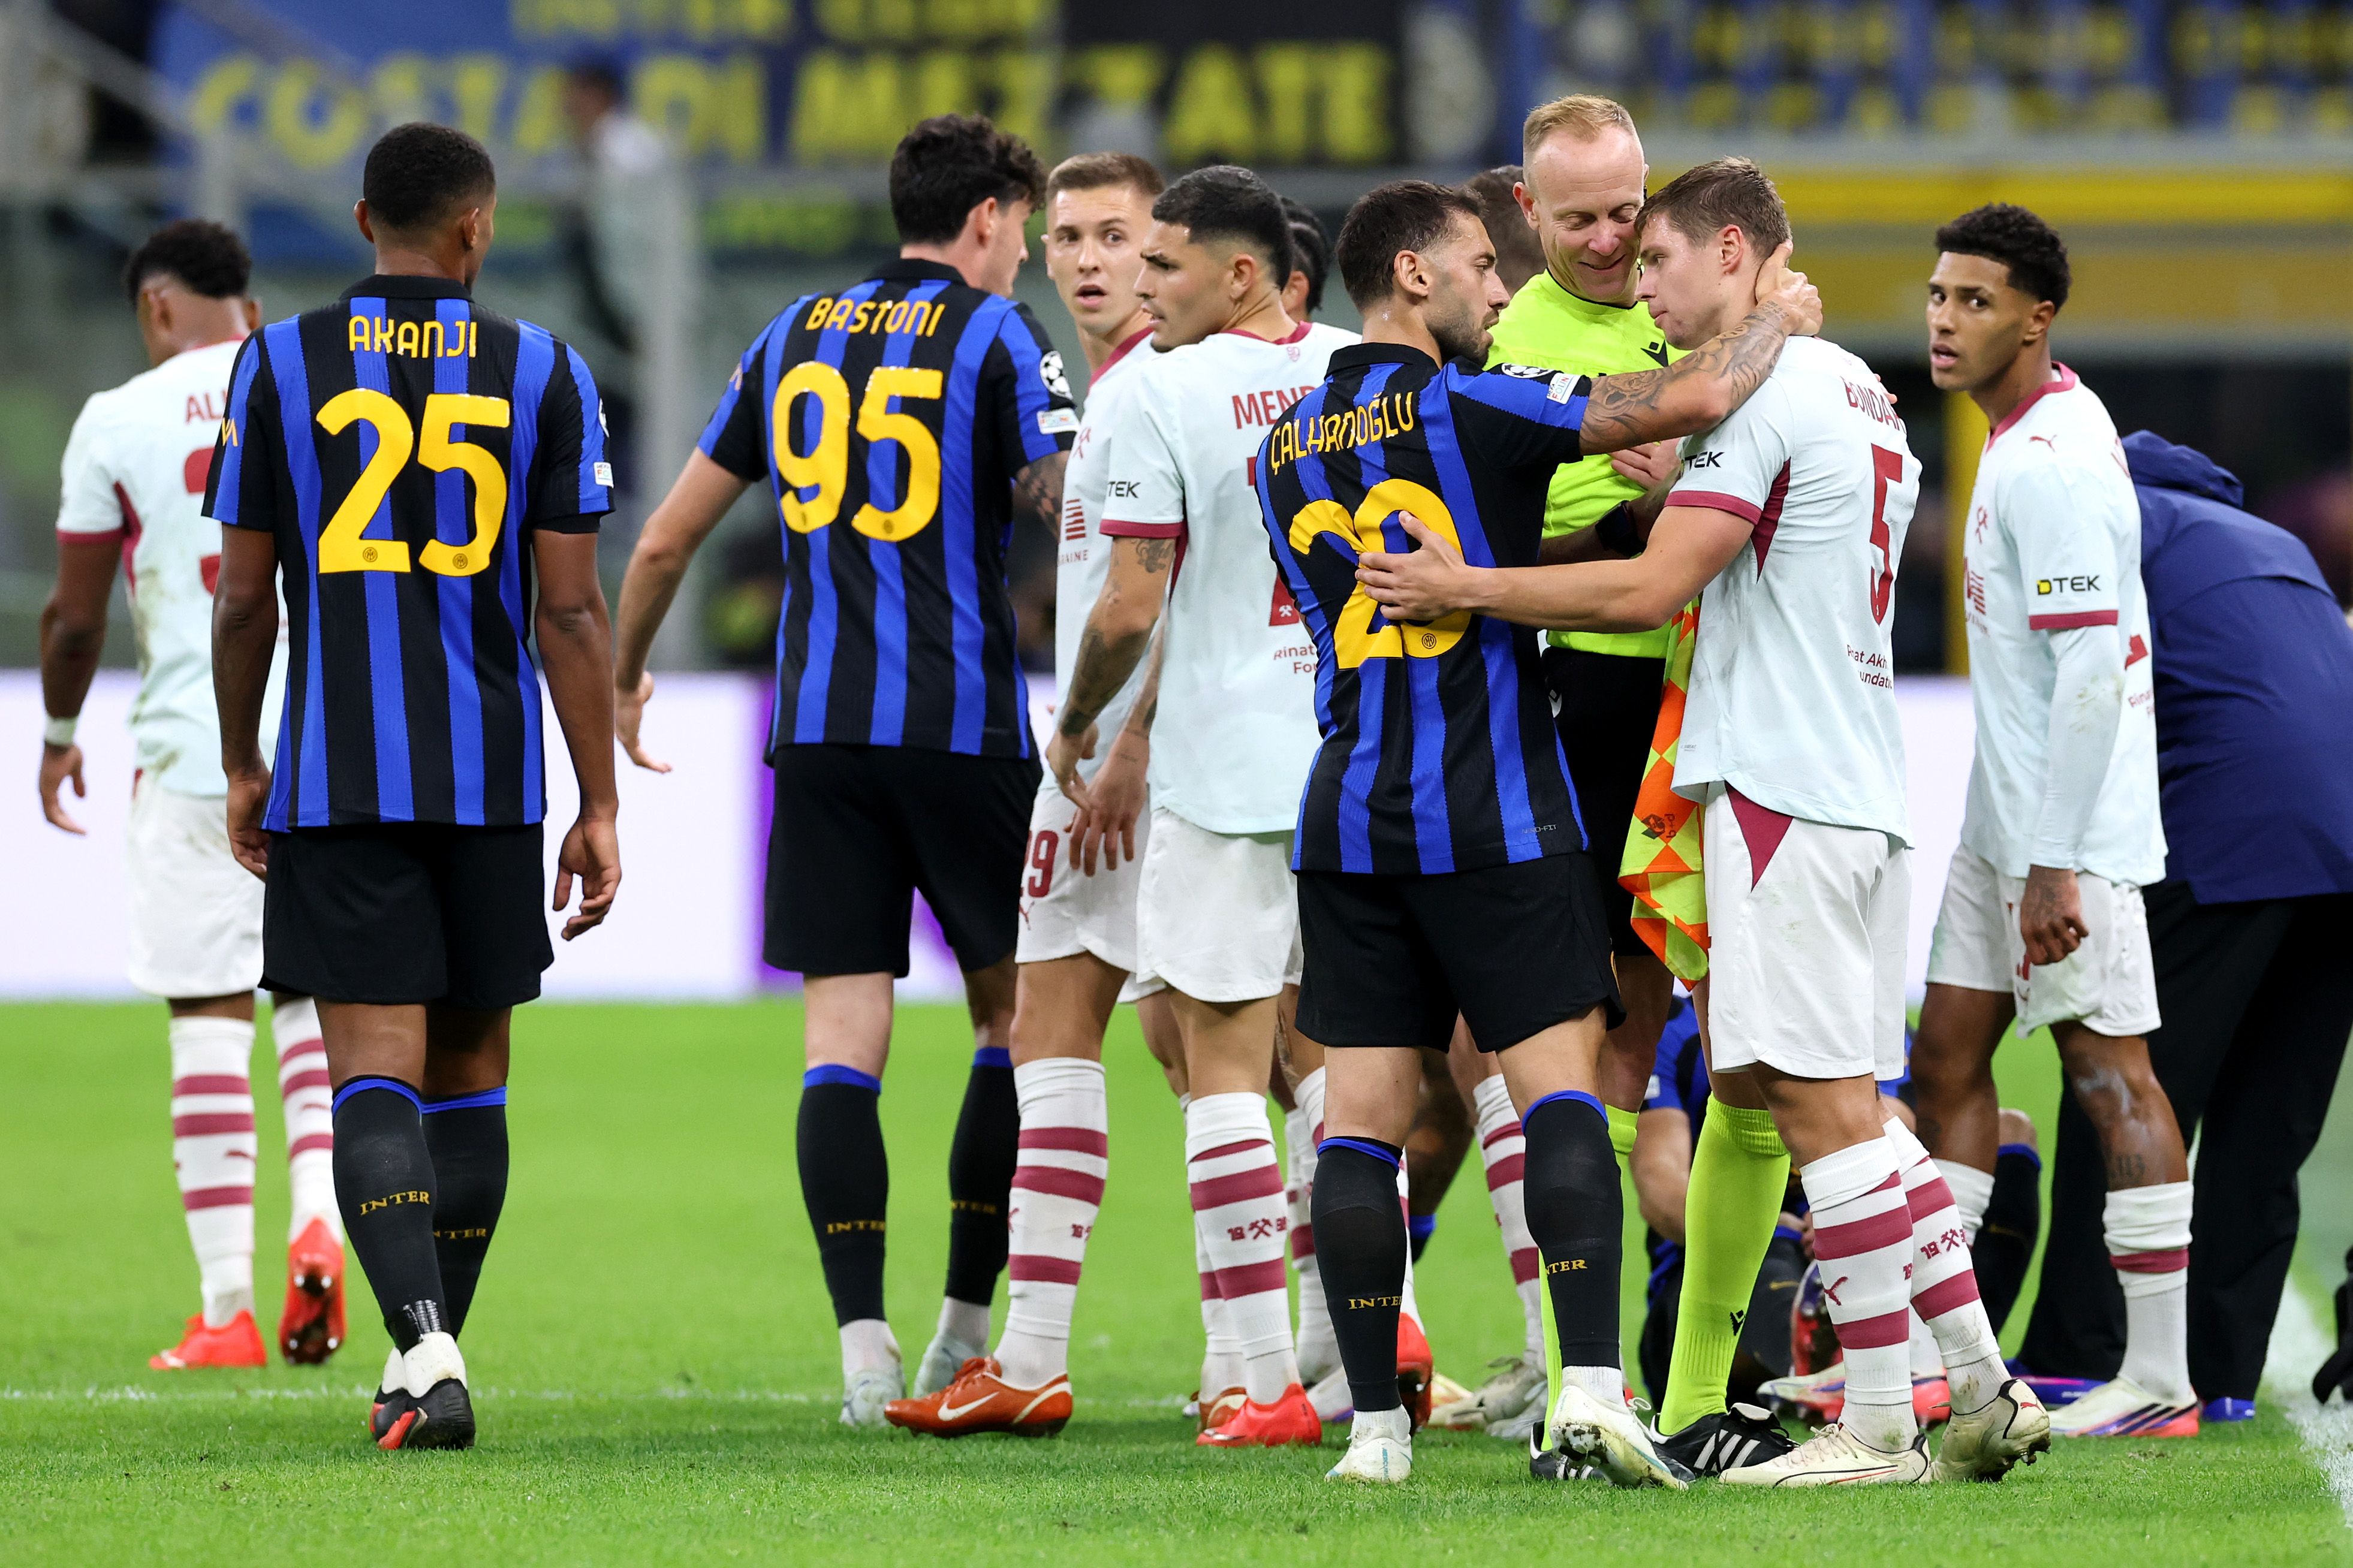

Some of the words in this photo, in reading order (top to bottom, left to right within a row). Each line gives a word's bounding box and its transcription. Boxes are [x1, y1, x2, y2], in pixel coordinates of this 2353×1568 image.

[348, 315, 477, 358] AKANJI
[805, 297, 946, 337] BASTONI
[772, 361, 943, 542] 95
[1271, 391, 1414, 475] ÇALHANOĞLU
[316, 388, 510, 577] 25
[1870, 443, 1903, 626] 5
[2036, 575, 2101, 595] DTEK
[1273, 644, 1315, 661] Rinat
[1020, 830, 1059, 897] 9
[360, 1190, 430, 1216] INTER
